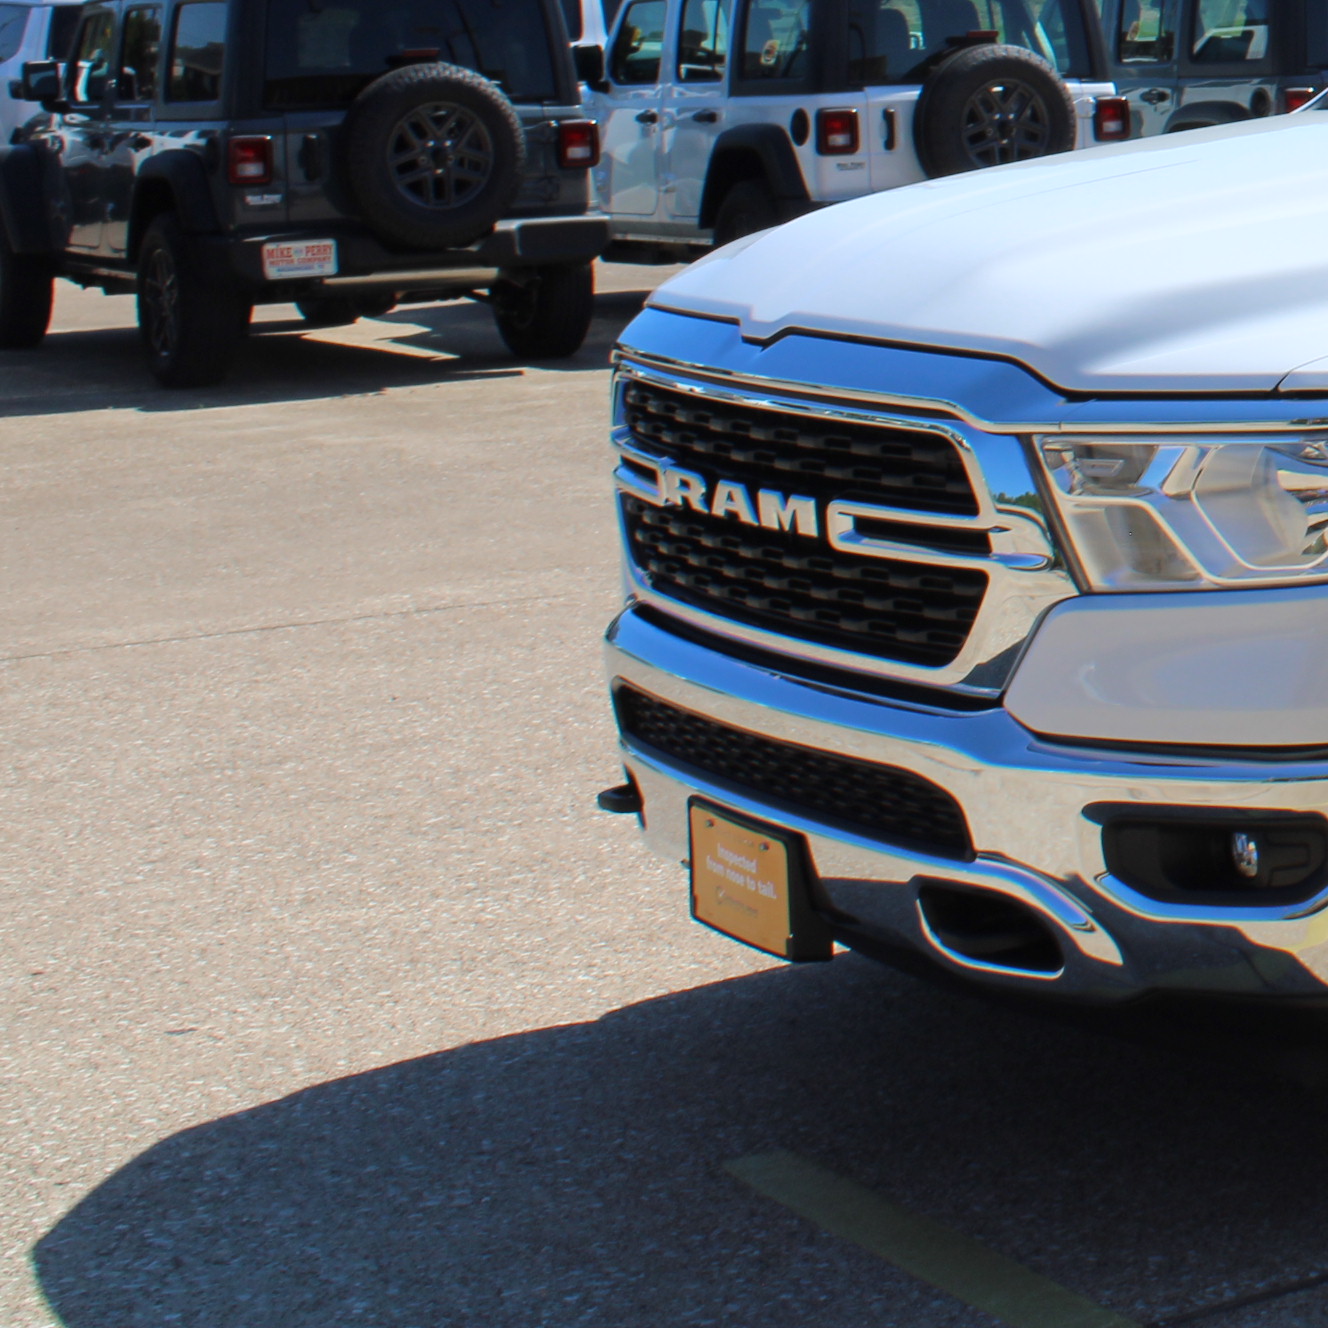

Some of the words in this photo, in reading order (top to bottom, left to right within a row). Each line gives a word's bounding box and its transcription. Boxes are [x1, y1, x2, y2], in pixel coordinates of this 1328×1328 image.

[266, 247, 293, 259] MIKE
[663, 465, 819, 538] RAM
[717, 842, 758, 874] Inspected
[706, 855, 725, 878] from
[726, 868, 746, 887] nose
[746, 875, 757, 891] to
[758, 880, 778, 900] tail.
